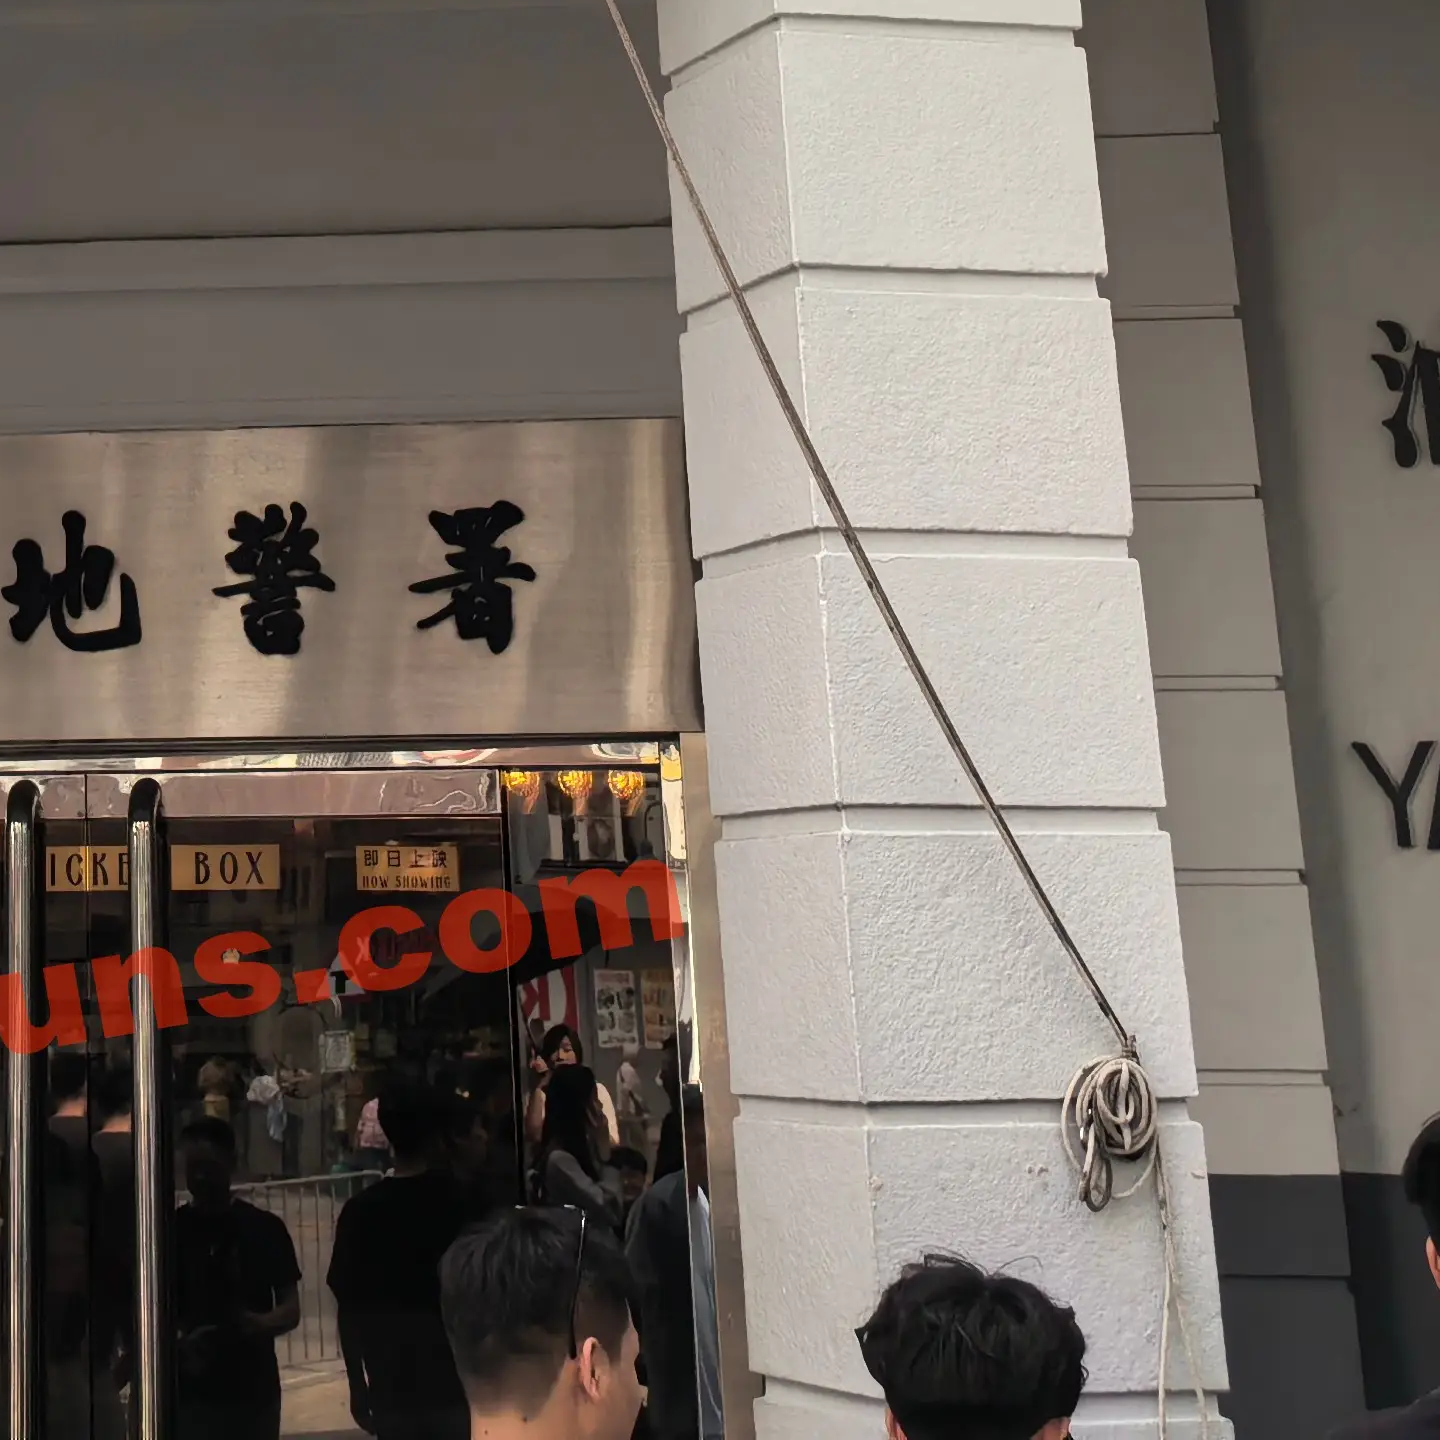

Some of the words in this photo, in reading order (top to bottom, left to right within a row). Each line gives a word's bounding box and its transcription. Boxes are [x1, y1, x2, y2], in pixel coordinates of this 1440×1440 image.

[50, 852, 128, 886] ICKE
[194, 851, 264, 885] BOX
[362, 875, 389, 889] NOW
[395, 875, 451, 889] SHOWING
